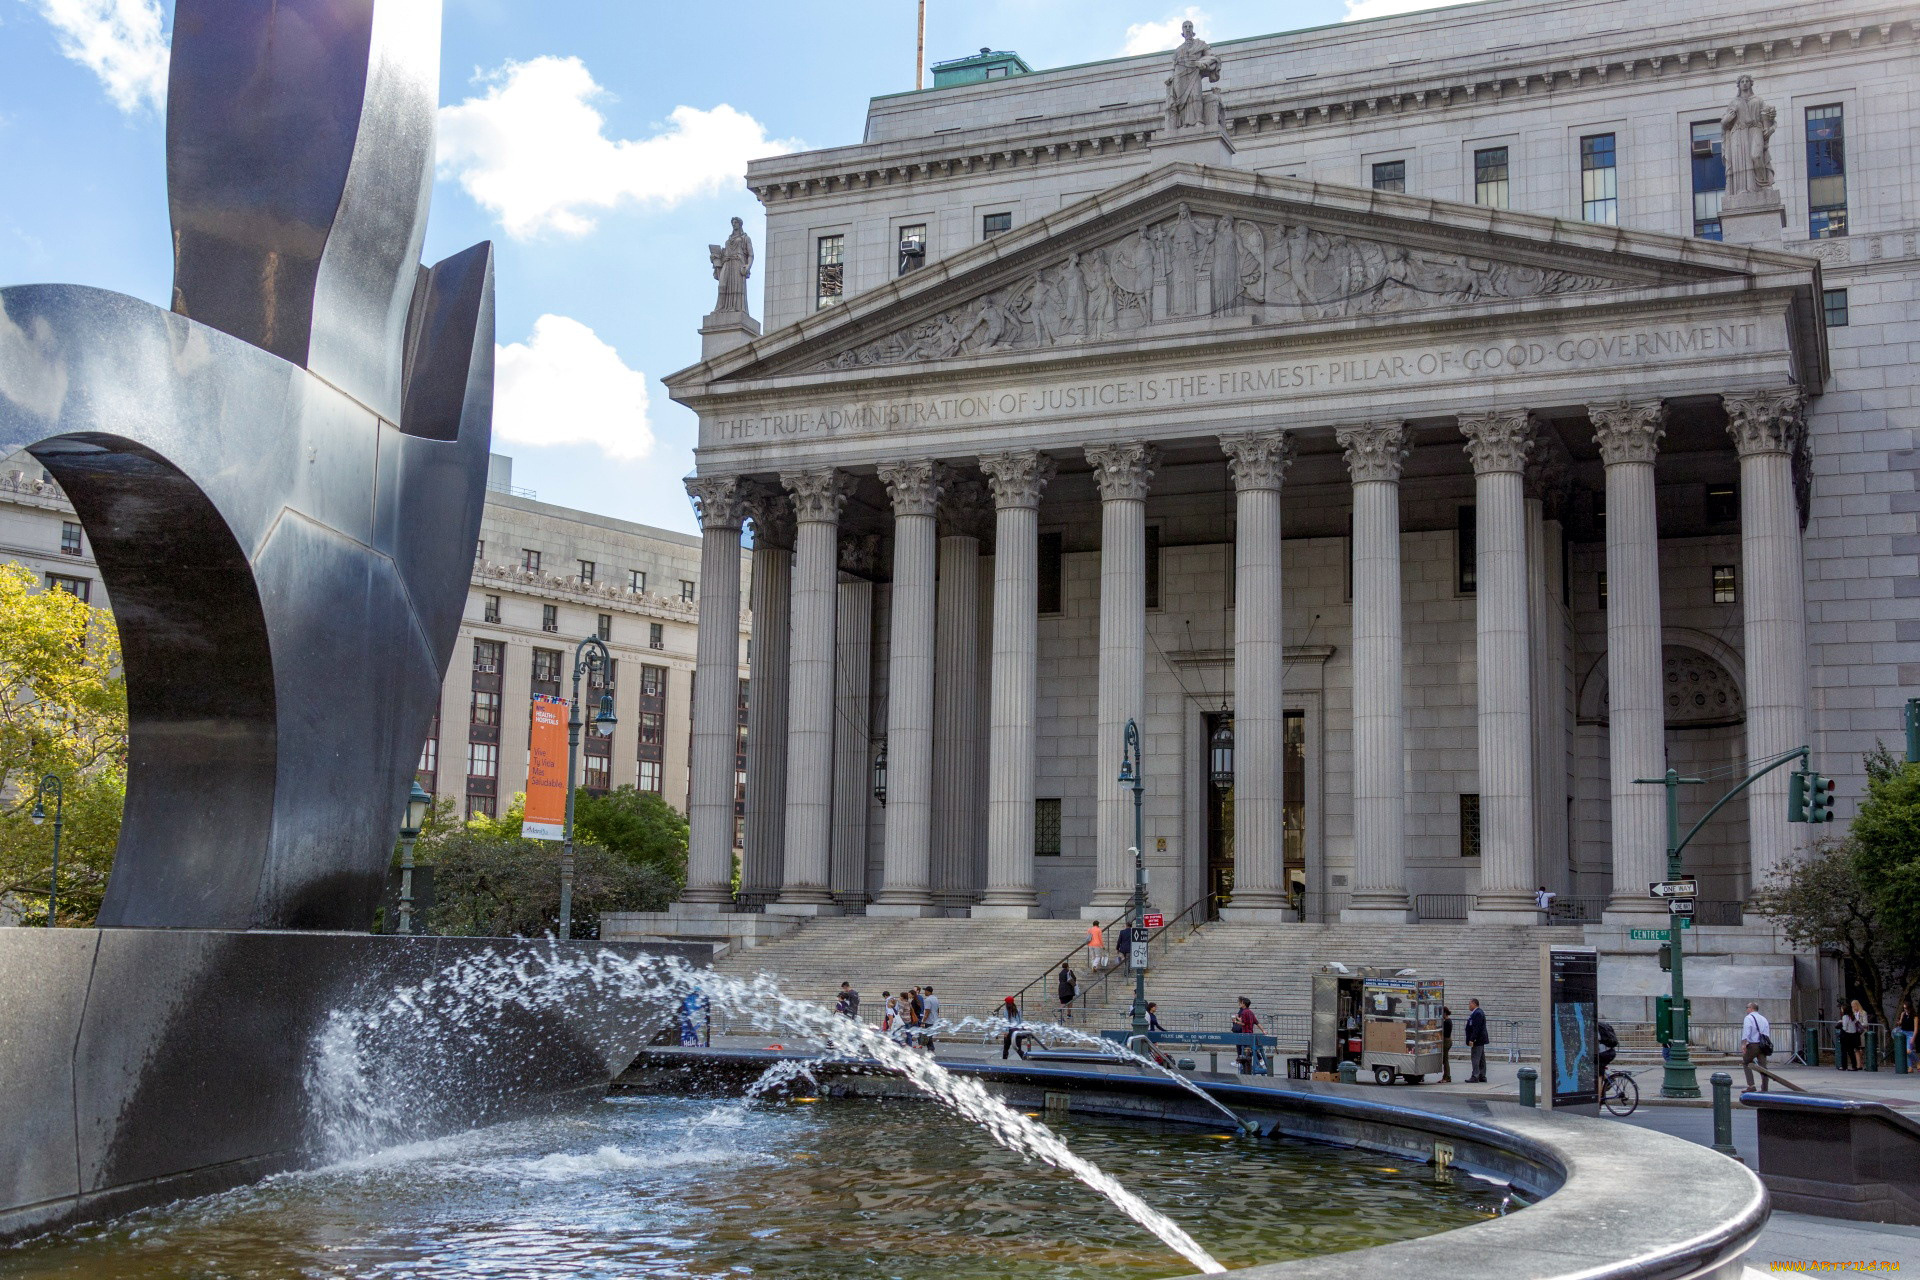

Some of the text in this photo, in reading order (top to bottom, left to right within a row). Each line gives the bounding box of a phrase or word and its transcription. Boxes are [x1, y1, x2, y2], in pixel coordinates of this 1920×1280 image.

[718, 323, 1756, 439] THE TRUE ADMINISTRATION OF JUSTICE IS THE FIRMEST PILLAR OF GOOD GOVERNMENT
[1633, 929, 1660, 940] CENTRE
